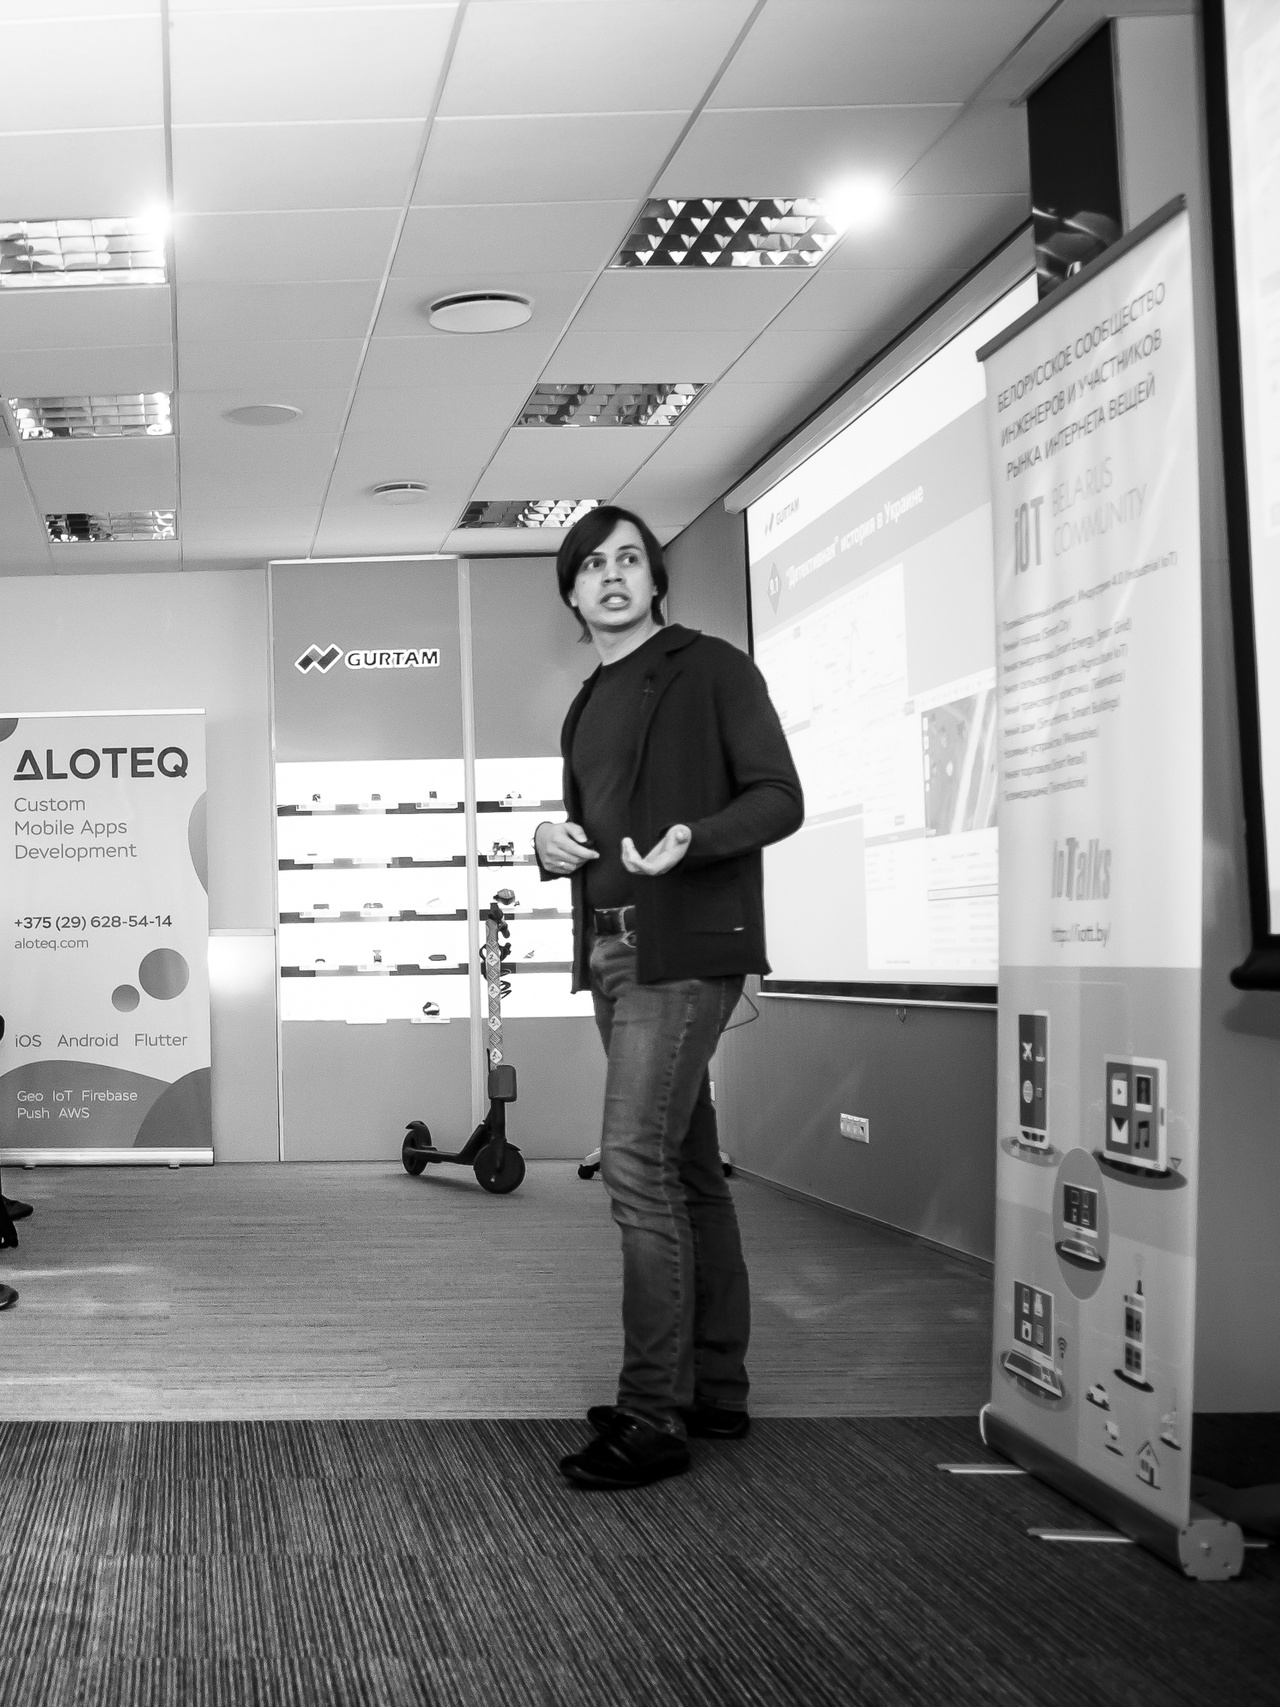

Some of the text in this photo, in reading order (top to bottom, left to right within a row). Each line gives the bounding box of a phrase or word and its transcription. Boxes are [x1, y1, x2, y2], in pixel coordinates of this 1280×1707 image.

[997, 282, 1166, 414] БЕЛОРУССКОЕ СООБЩЕСТВО
[1000, 328, 1162, 447] ИНЖЕНЕРОВ И УЧАСТНИКОВ
[1006, 371, 1156, 481] РЫНКА ИНТЕРНЕТА ВЕЩЕЙ
[1052, 456, 1113, 517] BELARUS
[840, 517, 876, 553] история
[876, 512, 884, 529] в
[883, 485, 924, 524] Украине
[1053, 483, 1148, 556] COMMUNITY
[346, 649, 439, 668] GURTAM
[13, 746, 189, 781] ALOTEQ
[14, 797, 86, 812] Custom
[14, 819, 128, 838] Mobile Apps
[15, 843, 138, 862] Development
[14, 915, 173, 932] +375 (29) 628-54-14
[14, 937, 89, 951] aloteq.com
[14, 1033, 188, 1048] iOS Android Flutter
[16, 1089, 138, 1102] Geo IoT Firebase
[17, 1107, 90, 1119] Push AWS
